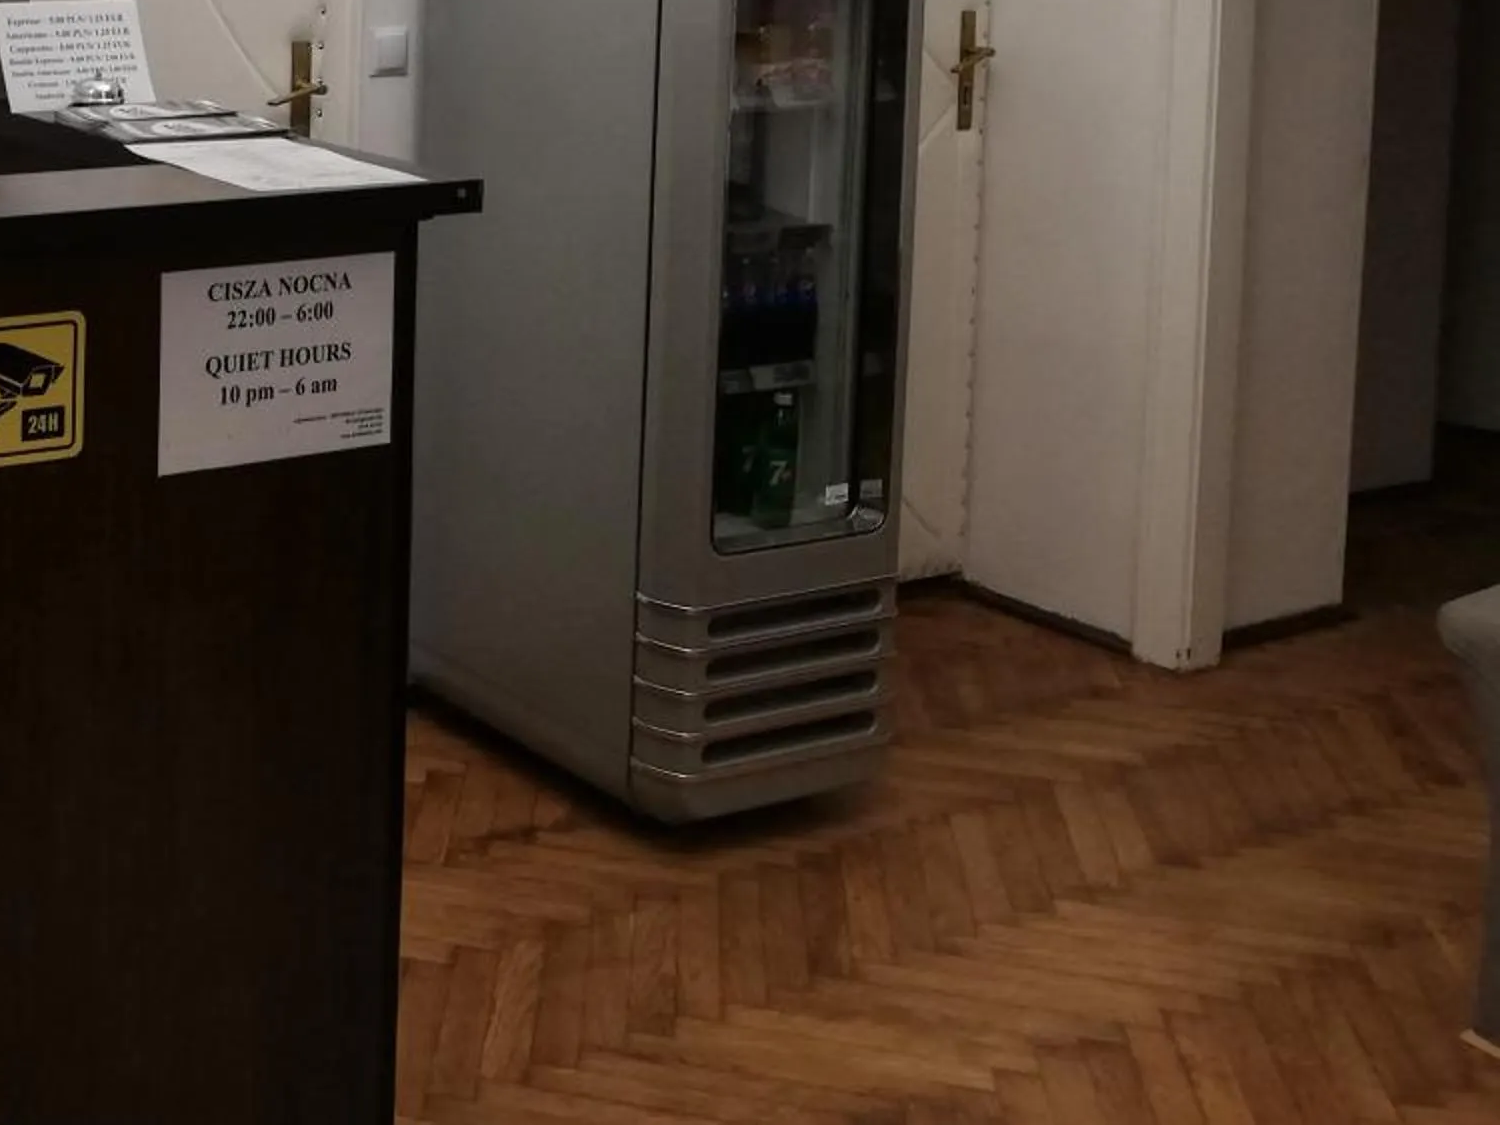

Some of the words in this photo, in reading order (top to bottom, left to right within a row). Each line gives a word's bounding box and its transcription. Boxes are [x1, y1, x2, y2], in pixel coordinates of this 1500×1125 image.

[208, 278, 272, 302] CISZA
[279, 272, 352, 296] NOCNA
[227, 307, 275, 330] 22:00
[296, 301, 333, 323] 6:00
[205, 350, 274, 379] QUIET
[279, 342, 352, 368] HOURS
[220, 385, 240, 406] 10
[245, 385, 274, 407] pm
[295, 377, 305, 396] 6
[311, 378, 338, 394] am
[28, 412, 59, 434] 24H
